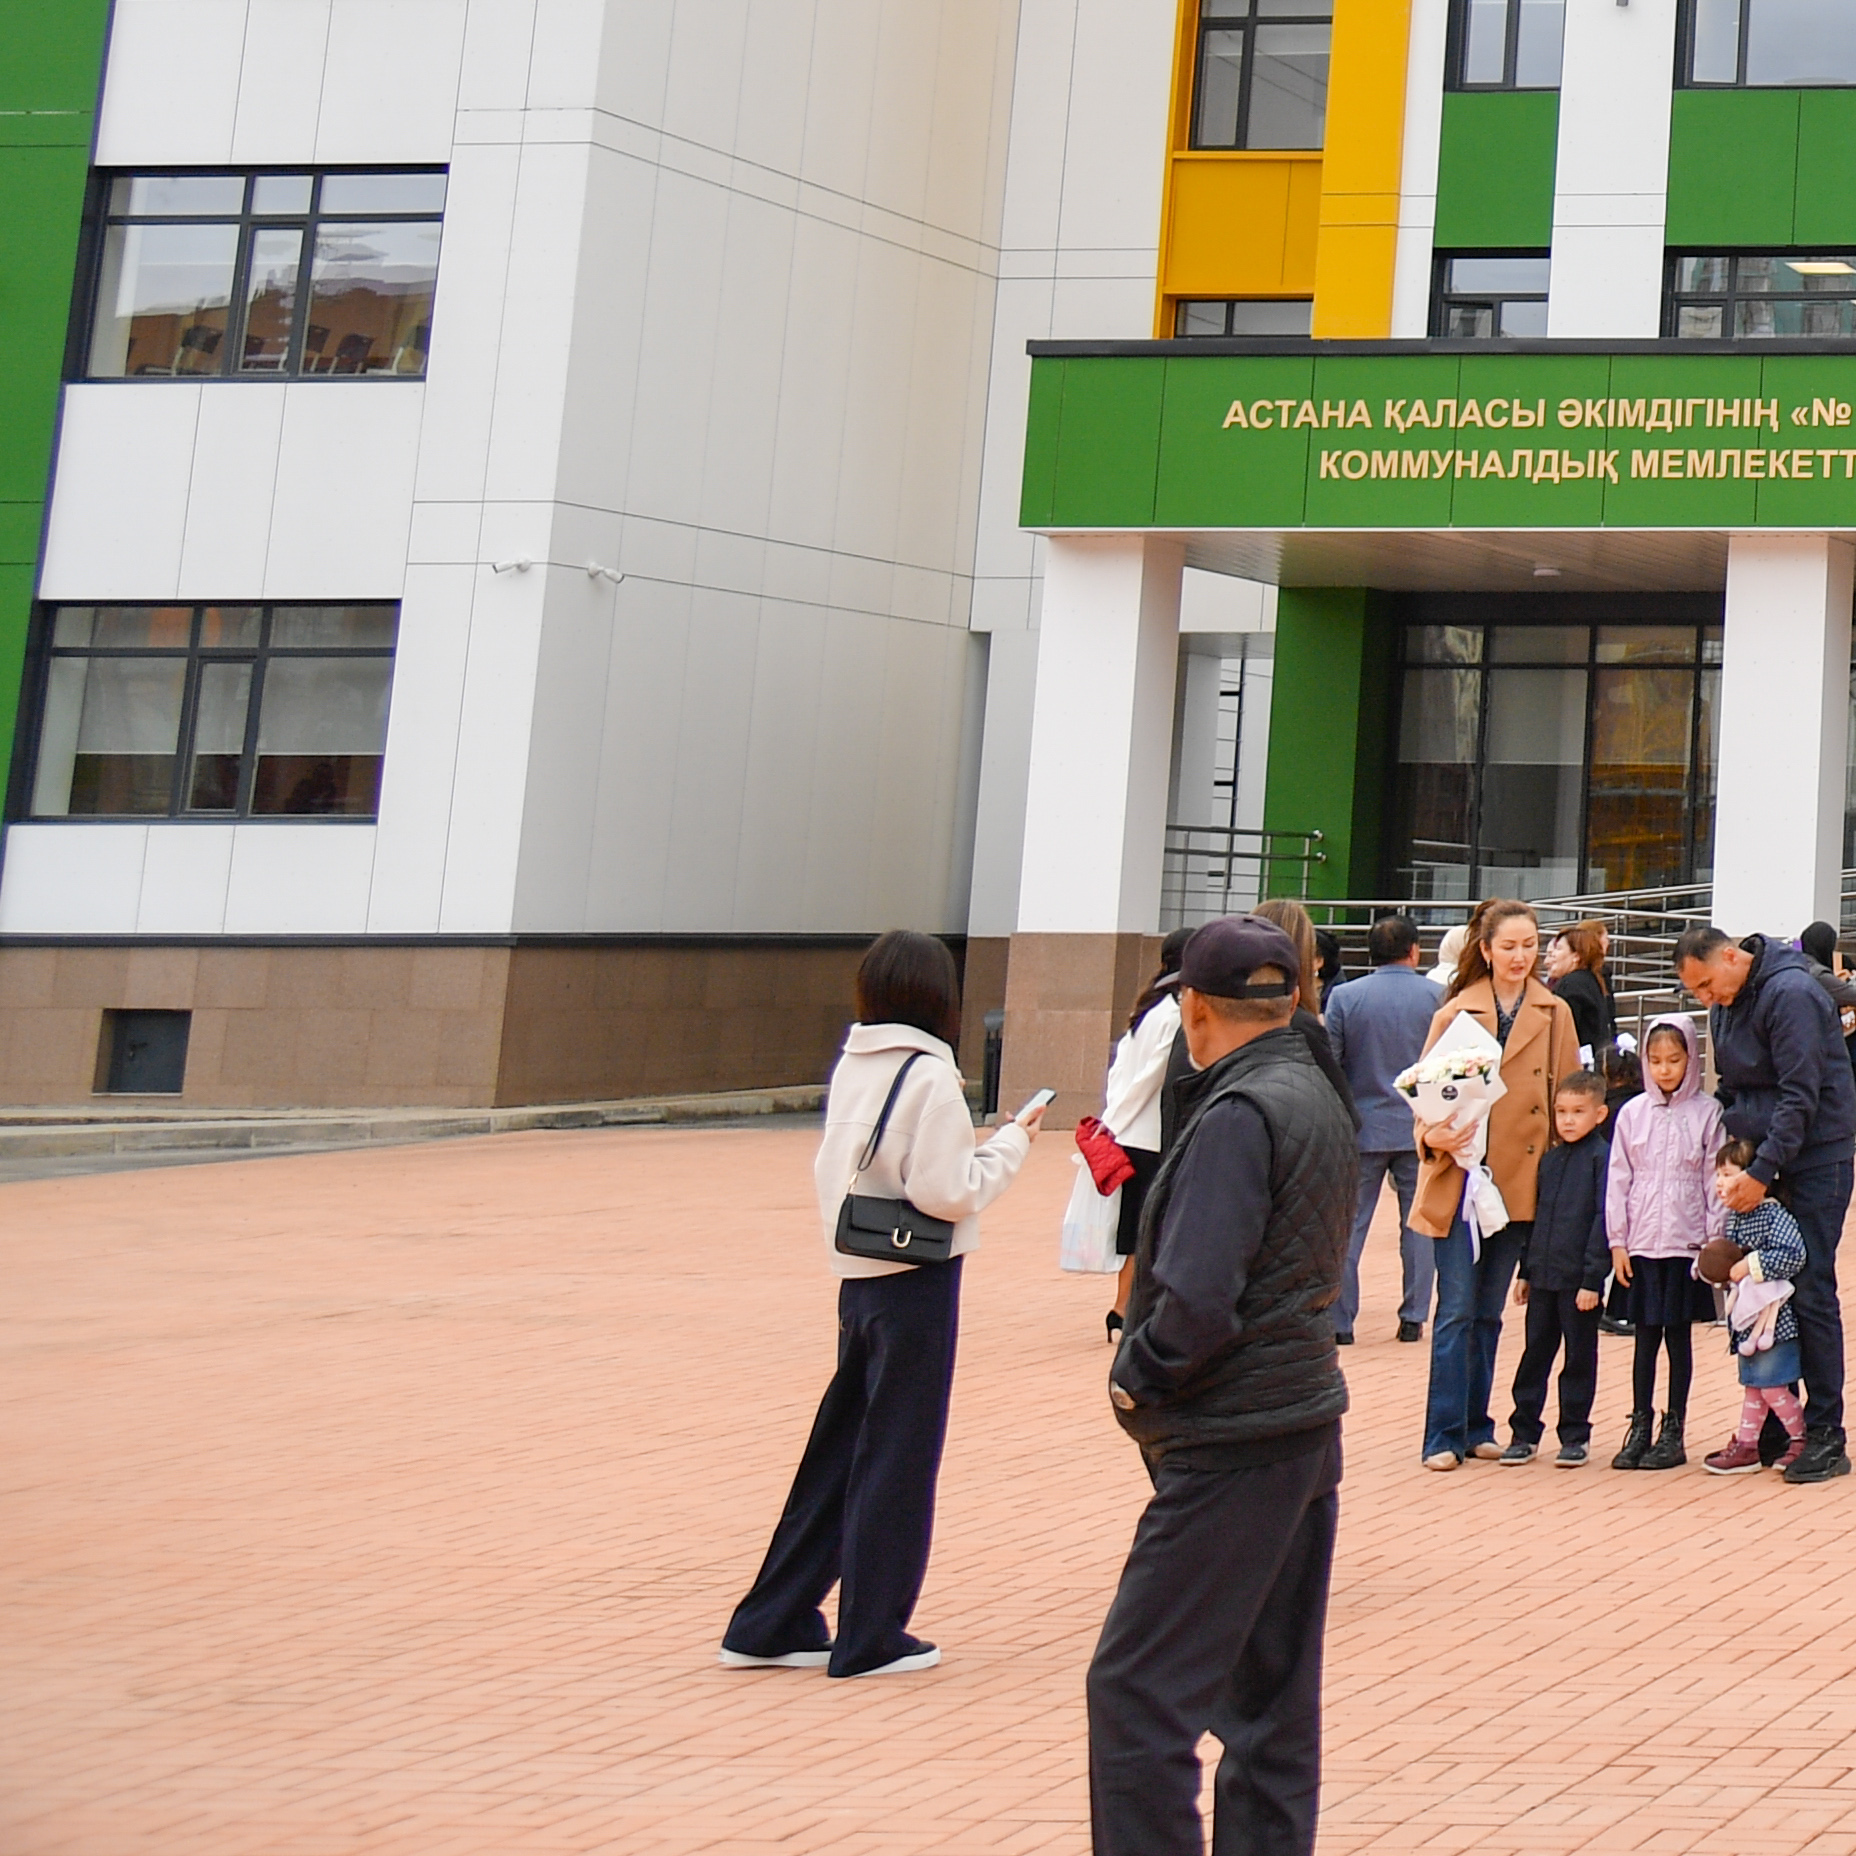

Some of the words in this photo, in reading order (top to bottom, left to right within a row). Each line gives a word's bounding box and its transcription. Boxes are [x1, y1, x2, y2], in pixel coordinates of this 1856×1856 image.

[1222, 399, 1373, 429] АСТАНА
[1384, 398, 1546, 434] ҚАЛАСЫ
[1557, 398, 1779, 434] ӘКІМДІГІНІҢ
[1319, 449, 1620, 485] КОММУНАЛДЫҚ
